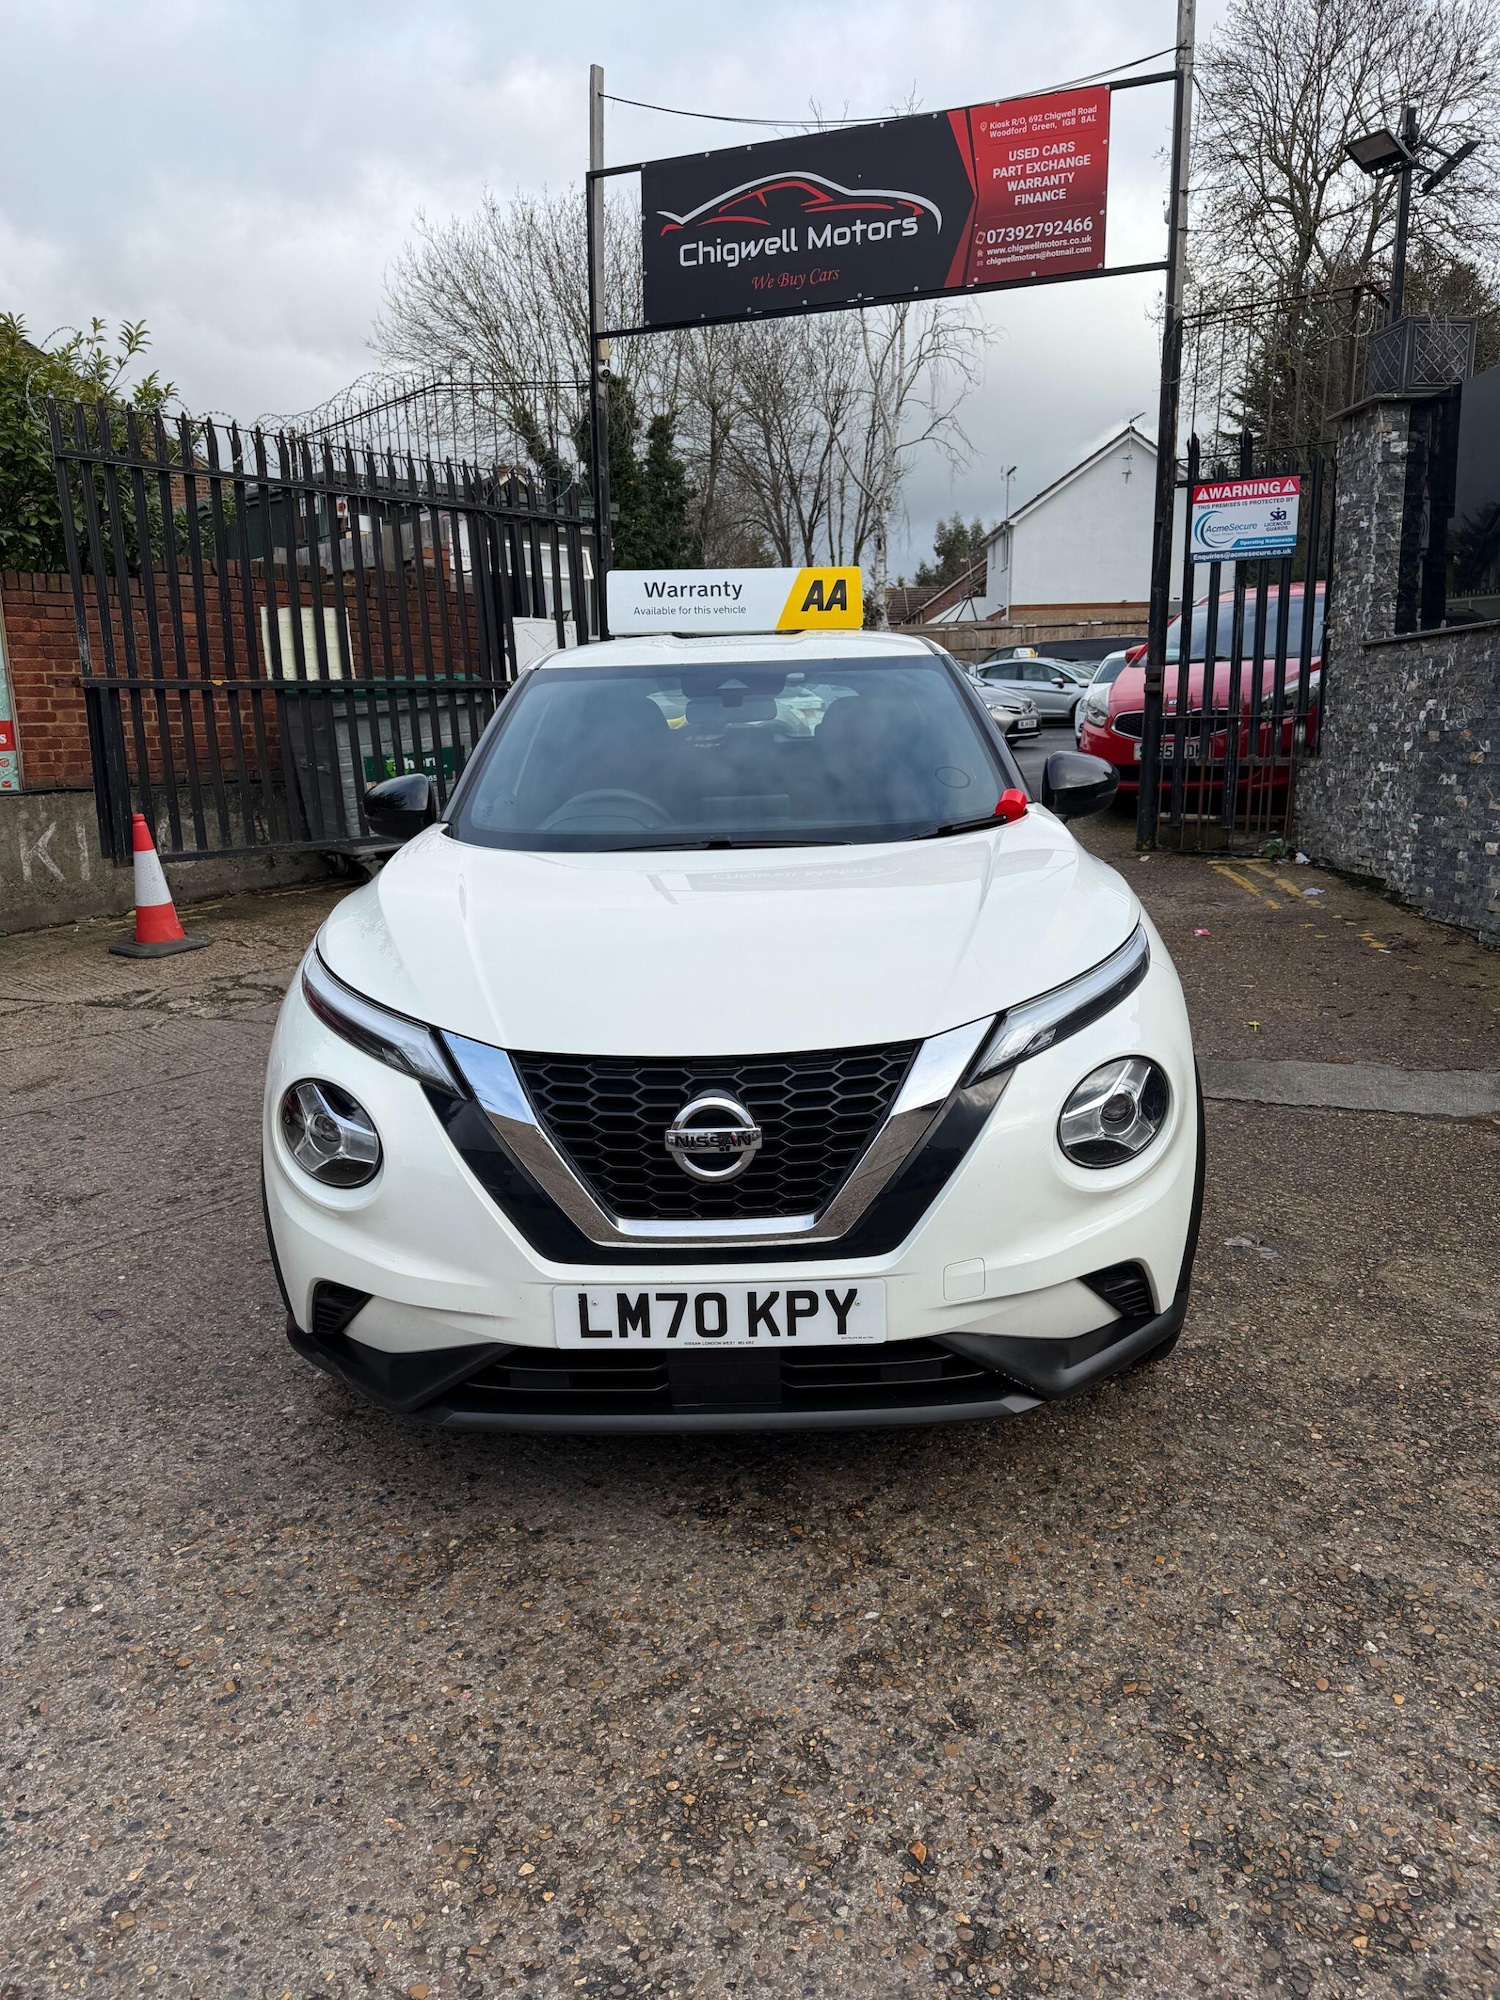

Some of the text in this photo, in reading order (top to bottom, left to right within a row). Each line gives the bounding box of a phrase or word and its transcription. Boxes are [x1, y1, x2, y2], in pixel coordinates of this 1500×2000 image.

[990, 120, 1010, 130] Kiosk
[1029, 114, 1042, 123] 692
[1044, 109, 1076, 121] Chigwell
[1078, 105, 1097, 115] Road
[990, 115, 1096, 138] Woodford Green, IG8 8AL
[1009, 141, 1075, 161] USED CARS
[993, 154, 1091, 179] PART EXCHANGE
[1007, 172, 1075, 192] WARRANTY
[1014, 188, 1067, 206] FINANCE
[986, 216, 1093, 244] 07392792466
[679, 217, 919, 268] Chigwell Motors
[986, 235, 1092, 256] www.chigwellmotors.co.uk
[986, 246, 1092, 266] chigwellmotors@hotmail.com
[752, 268, 840, 291] We Buy Cars
[1209, 481, 1280, 500] WARNING
[1270, 507, 1287, 521] sia
[1205, 523, 1257, 533] AcmeSecure
[1193, 549, 1292, 561] Enquiries@acmesecure.co.uk
[643, 580, 743, 600] Warranty
[801, 579, 847, 612] AA
[633, 604, 747, 616] Available for this vehicle
[675, 1133, 752, 1148] NISSAN
[578, 1288, 858, 1338] LM70 KPY
